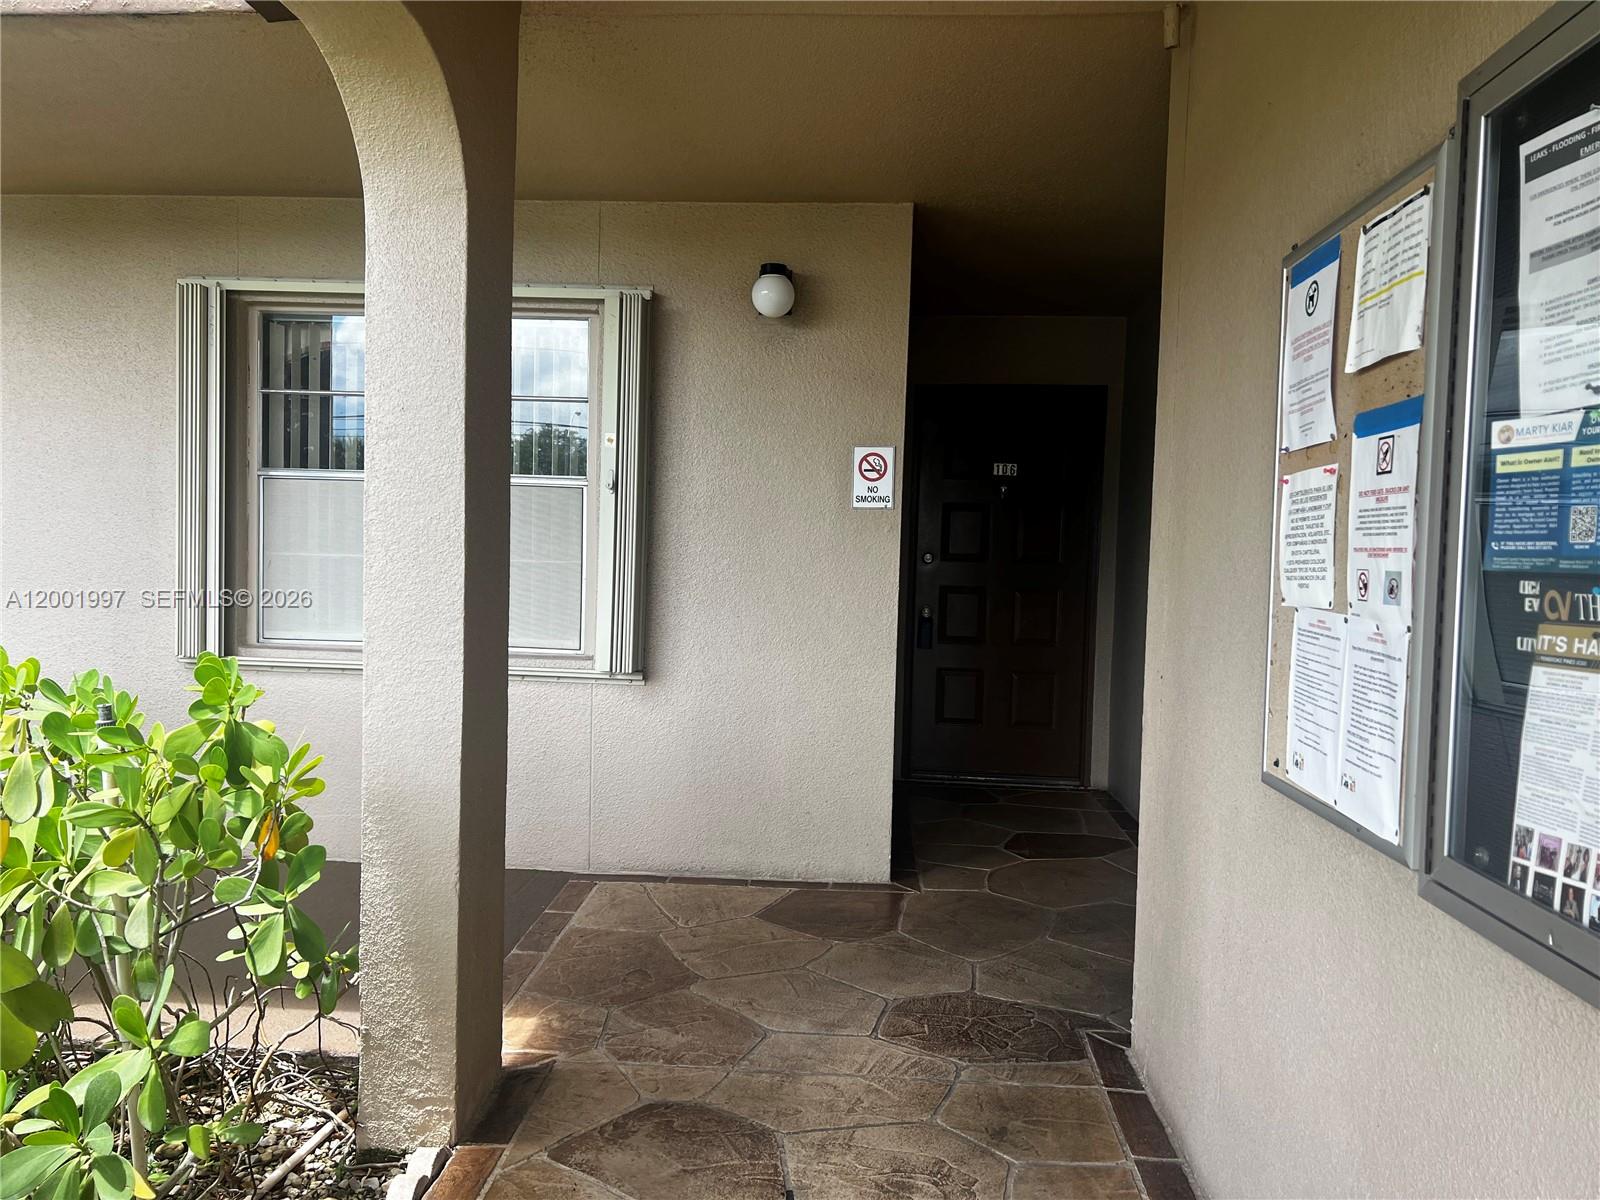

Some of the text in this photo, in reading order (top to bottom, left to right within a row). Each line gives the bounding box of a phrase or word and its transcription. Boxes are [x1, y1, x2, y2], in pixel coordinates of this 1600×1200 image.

[1530, 148, 1548, 162] LEAKS
[1552, 130, 1586, 153] FLOODING
[1516, 425, 1549, 436] MARTY
[1552, 421, 1573, 432] KIAR
[995, 464, 1017, 475] 106
[855, 495, 891, 503] SMOKING
[1573, 637, 1600, 656] HA
